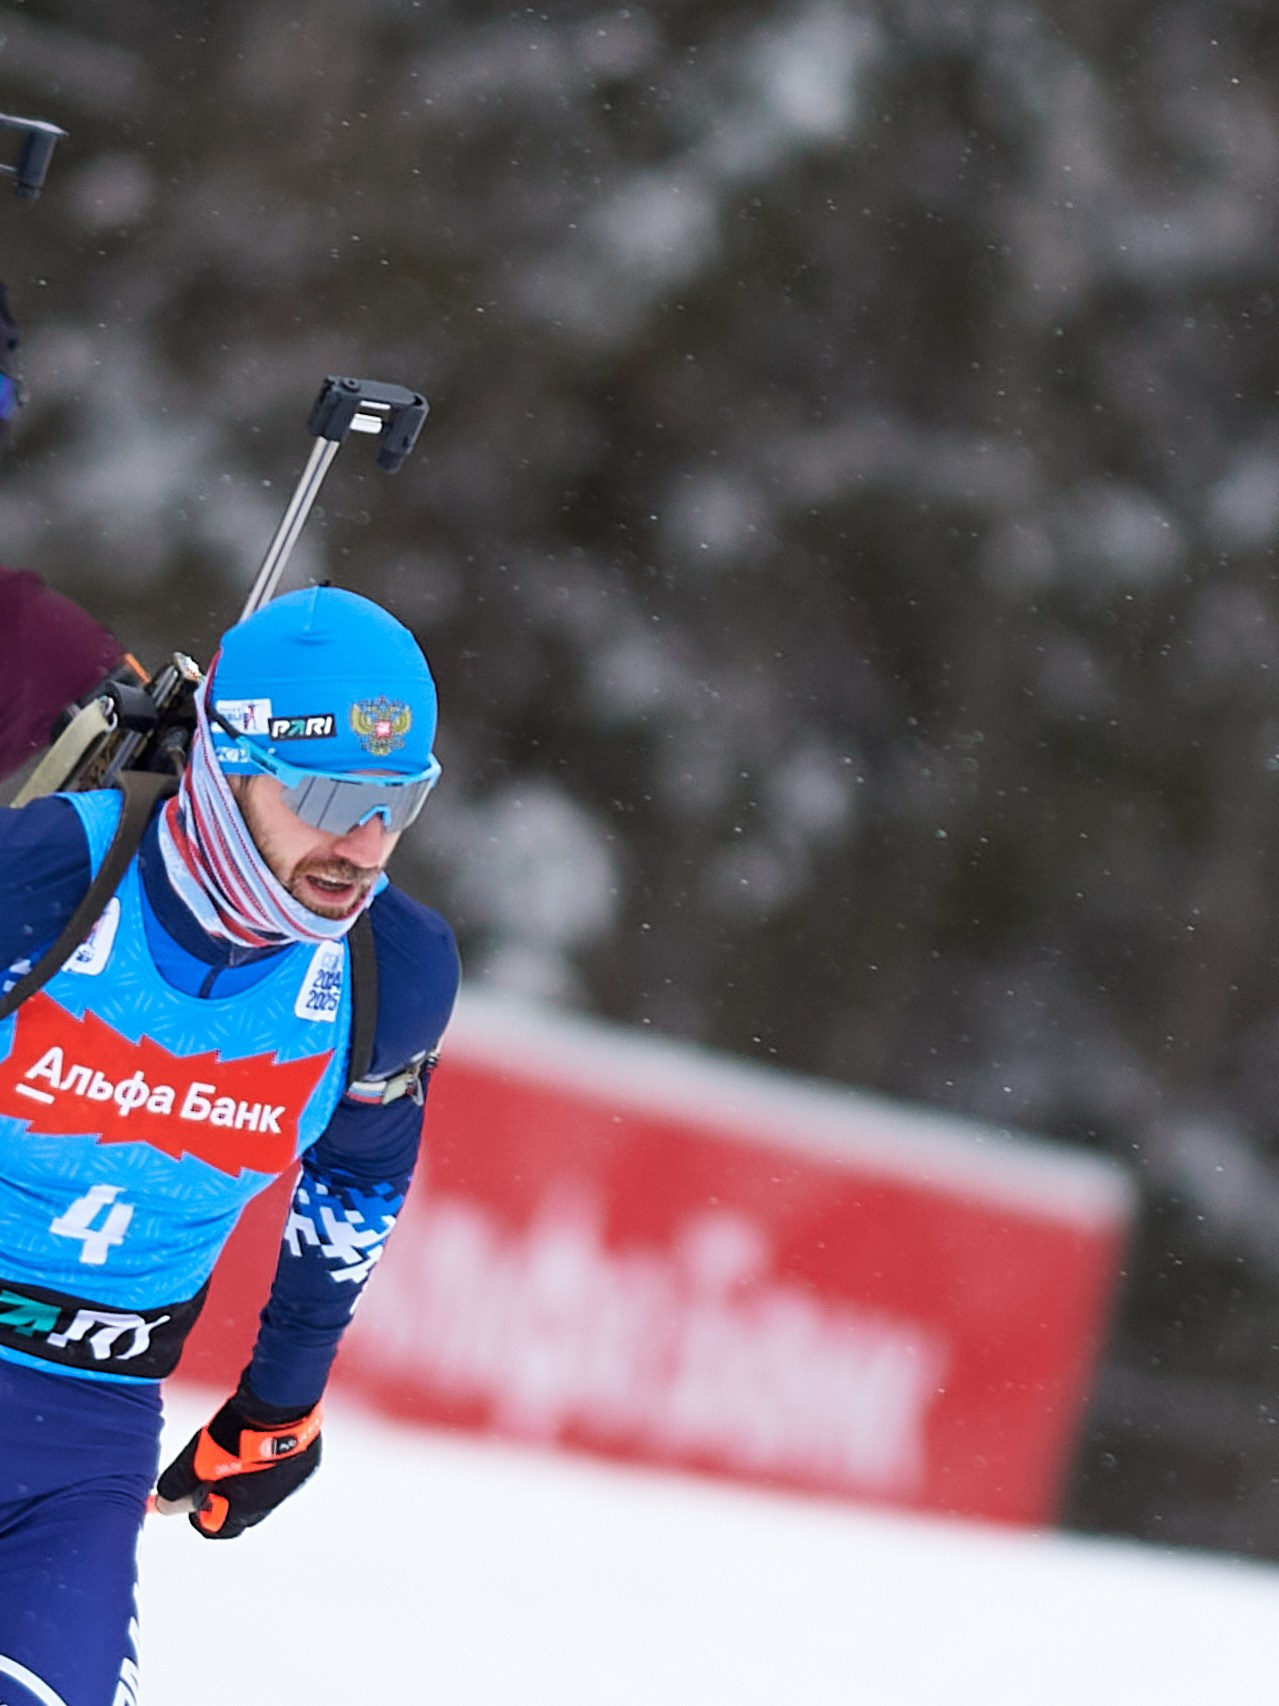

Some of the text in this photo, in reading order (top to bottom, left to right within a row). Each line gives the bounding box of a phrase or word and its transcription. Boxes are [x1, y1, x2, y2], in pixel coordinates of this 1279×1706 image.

[272, 717, 333, 737] PARI
[24, 1047, 287, 1134] Альфа Банк
[50, 1185, 134, 1265] 4
